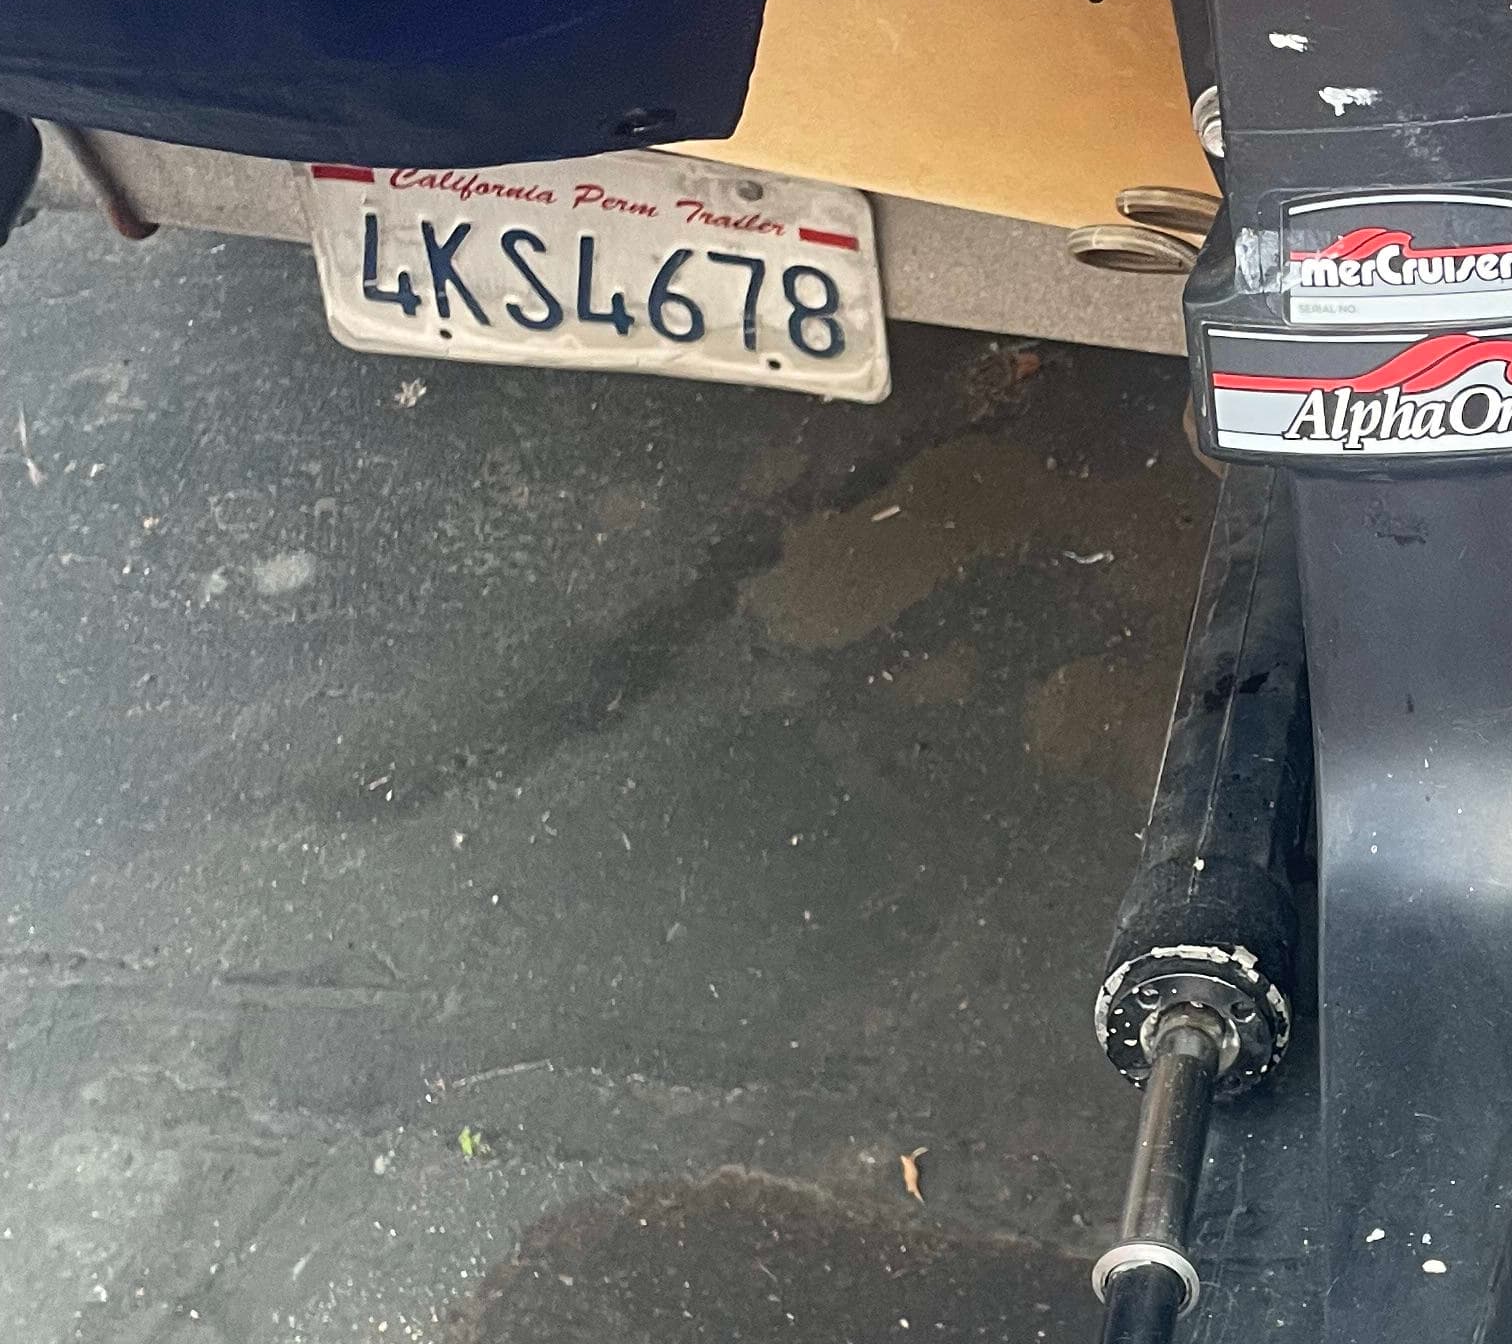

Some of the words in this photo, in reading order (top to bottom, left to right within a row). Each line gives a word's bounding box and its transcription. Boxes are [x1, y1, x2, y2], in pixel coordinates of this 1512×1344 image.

[390, 167, 558, 204] California
[572, 184, 659, 218] Perm
[676, 199, 785, 237] Trailer
[362, 213, 847, 358] 4KS4678
[1298, 305, 1336, 316] SERIAL
